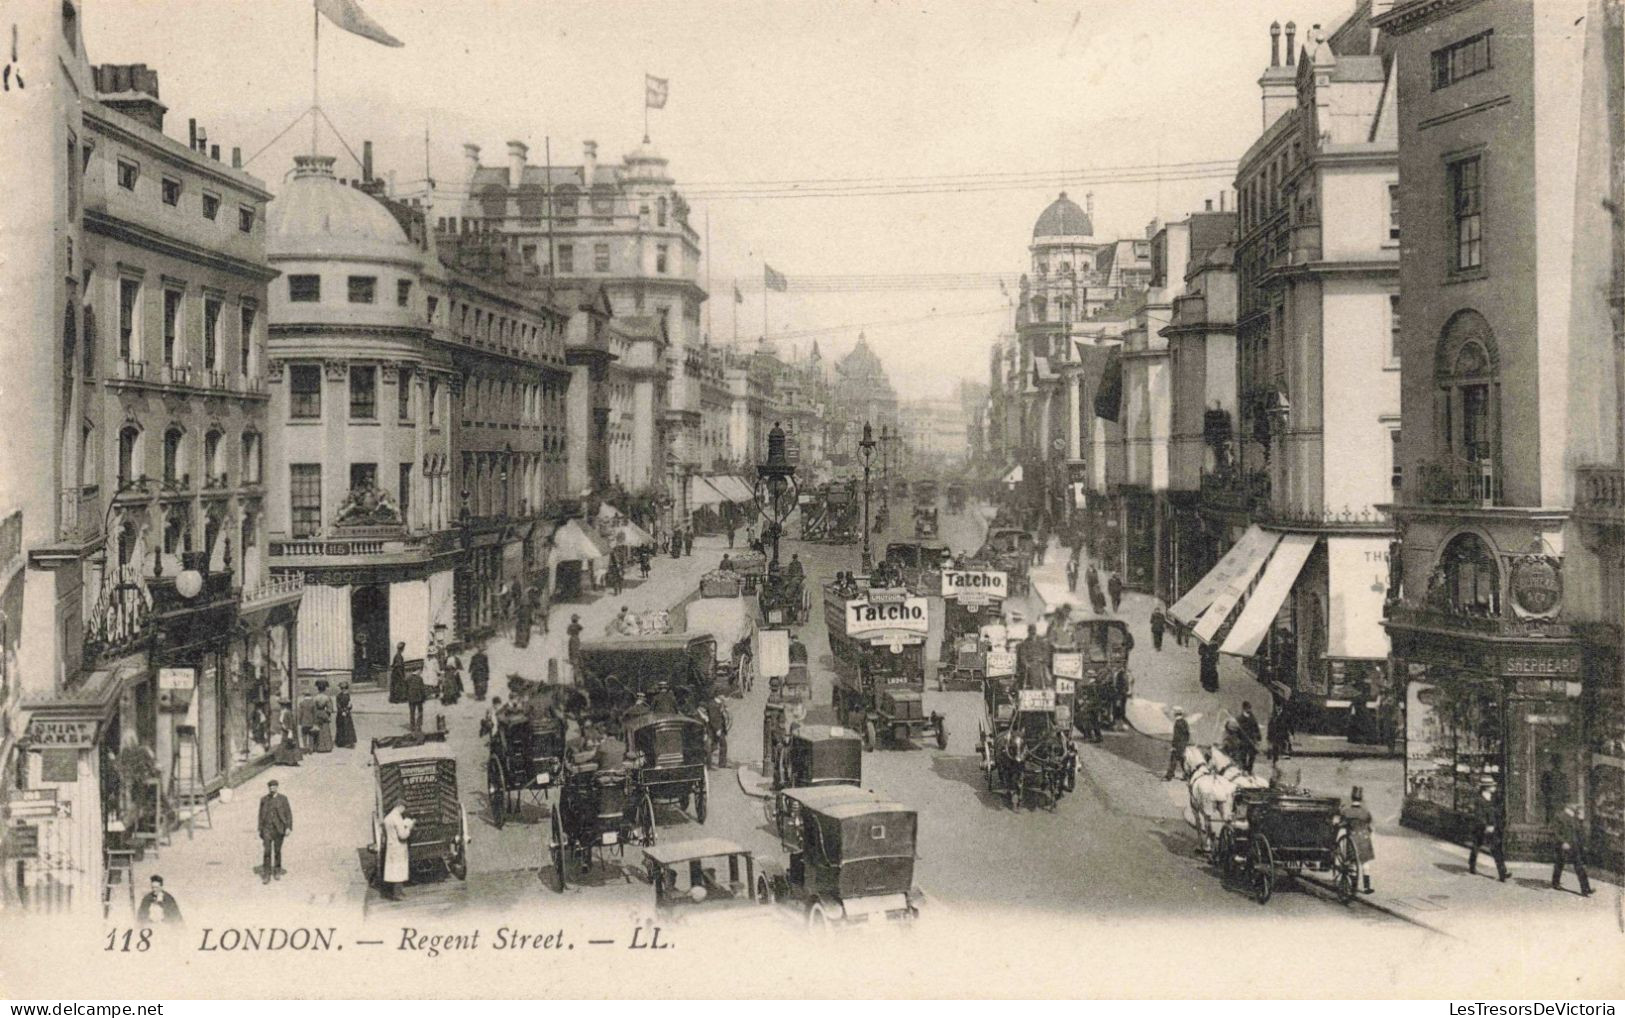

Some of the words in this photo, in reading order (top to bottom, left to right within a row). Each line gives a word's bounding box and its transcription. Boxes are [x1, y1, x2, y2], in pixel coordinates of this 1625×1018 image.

[944, 572, 1004, 588] Tatcho.
[850, 601, 926, 621] Tatcho.
[1507, 657, 1579, 673] SHEPHEARD
